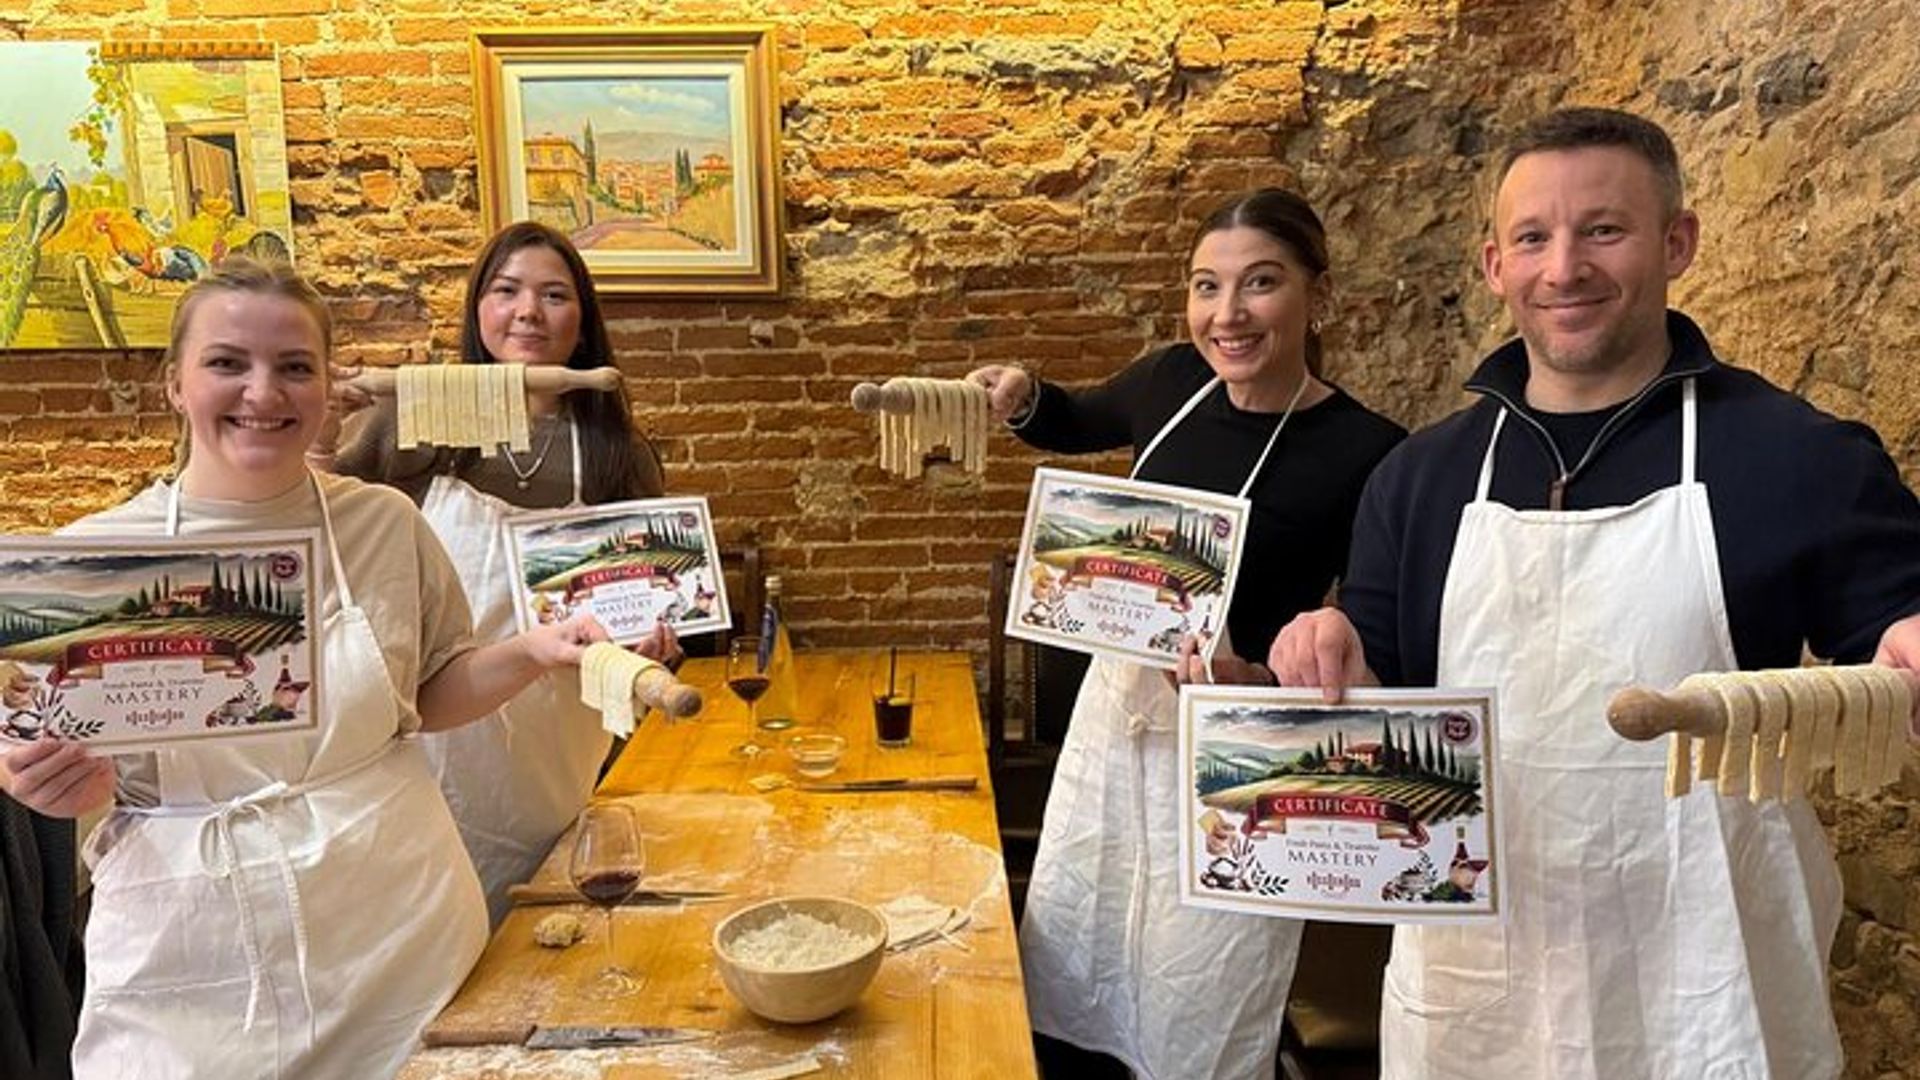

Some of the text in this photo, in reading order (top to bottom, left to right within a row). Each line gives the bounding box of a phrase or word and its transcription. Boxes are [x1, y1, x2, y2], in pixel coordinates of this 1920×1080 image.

[583, 565, 655, 585] CERTIFICATE
[1085, 561, 1167, 584] CERTIFICATE
[88, 640, 216, 659] CERTIFICATE
[104, 687, 204, 705] MASTERY
[1274, 798, 1389, 817] CERTIFICATE
[1287, 850, 1378, 867] MASTERY
